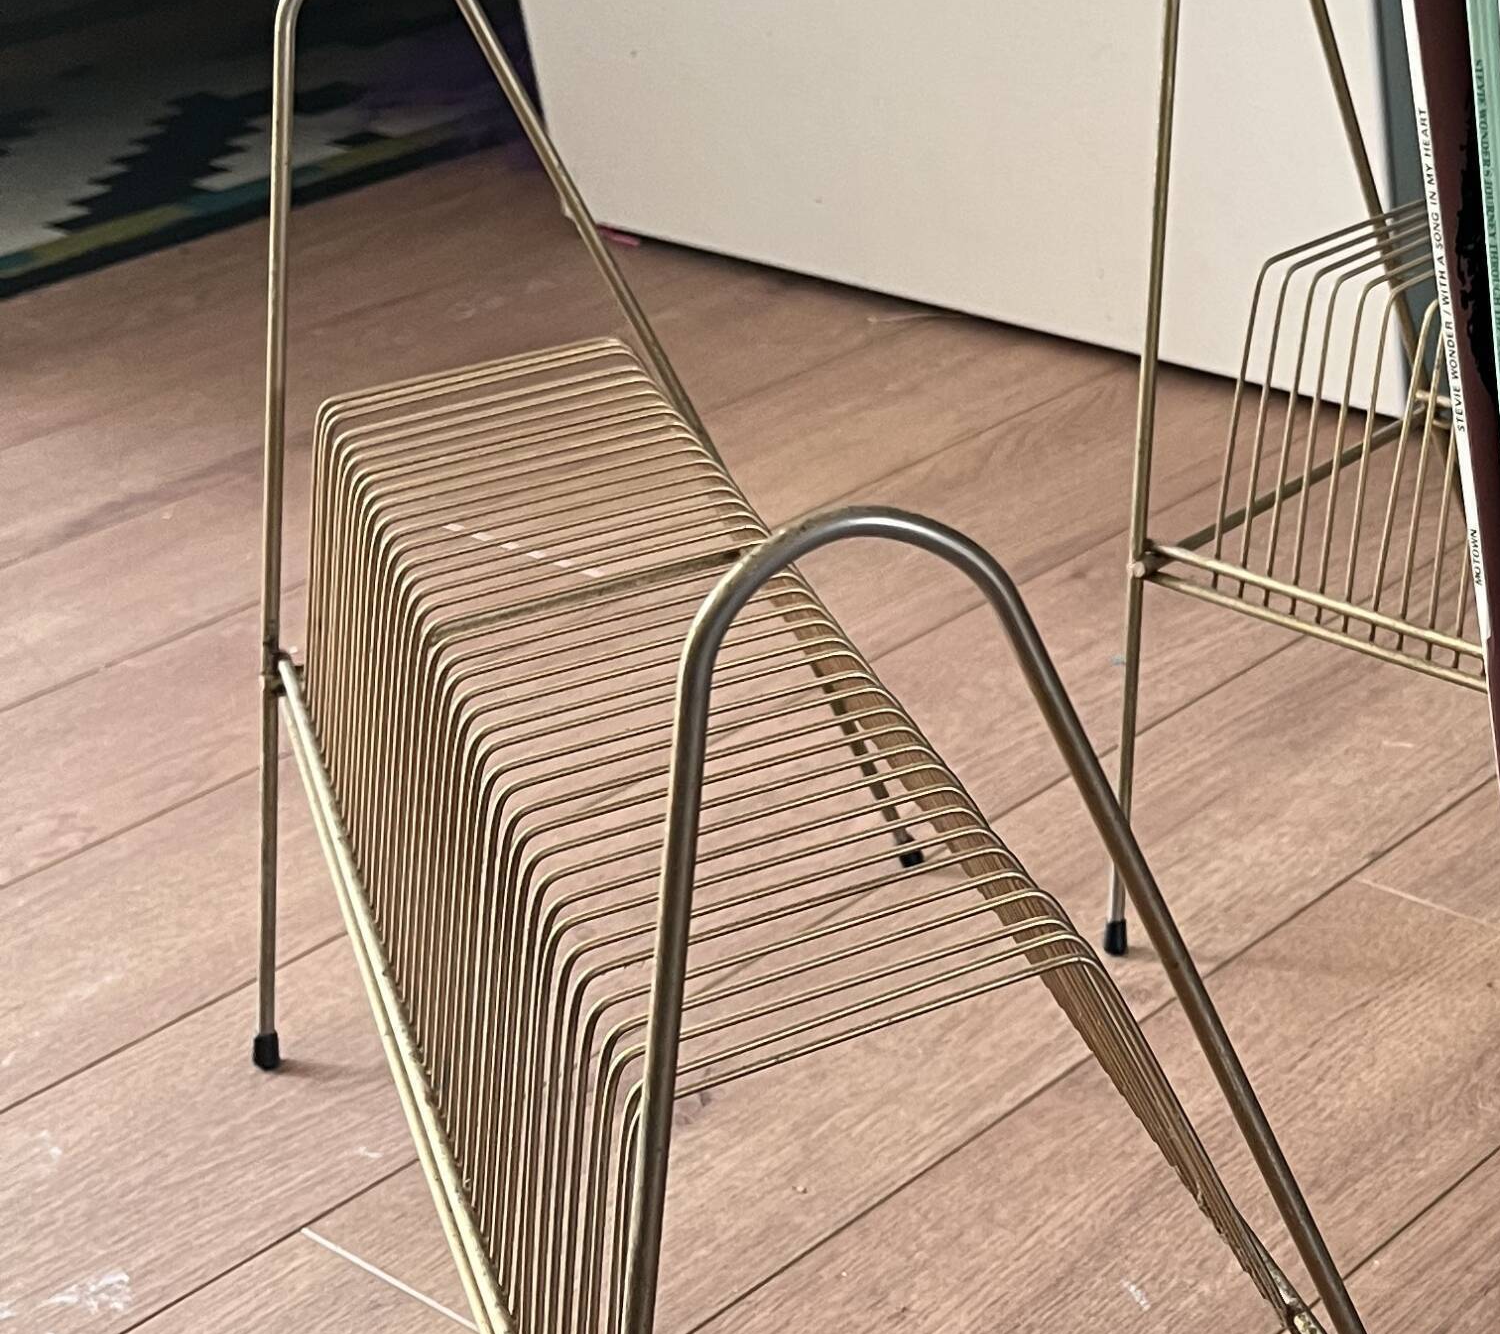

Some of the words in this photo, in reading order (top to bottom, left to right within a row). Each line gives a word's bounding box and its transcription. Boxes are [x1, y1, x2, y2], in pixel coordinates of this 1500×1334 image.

[1419, 109, 1433, 157] HEART
[1473, 58, 1487, 105] STEVIE
[1483, 179, 1497, 238] JOURNEY
[1425, 161, 1435, 187] MY
[1429, 191, 1438, 206] IN
[1431, 211, 1444, 250] SONG
[1435, 254, 1444, 266] A
[1439, 269, 1451, 307] WITH
[1444, 321, 1459, 380] WONDER
[1452, 387, 1466, 432] STEVIE
[1470, 528, 1483, 585] MOTOWN
